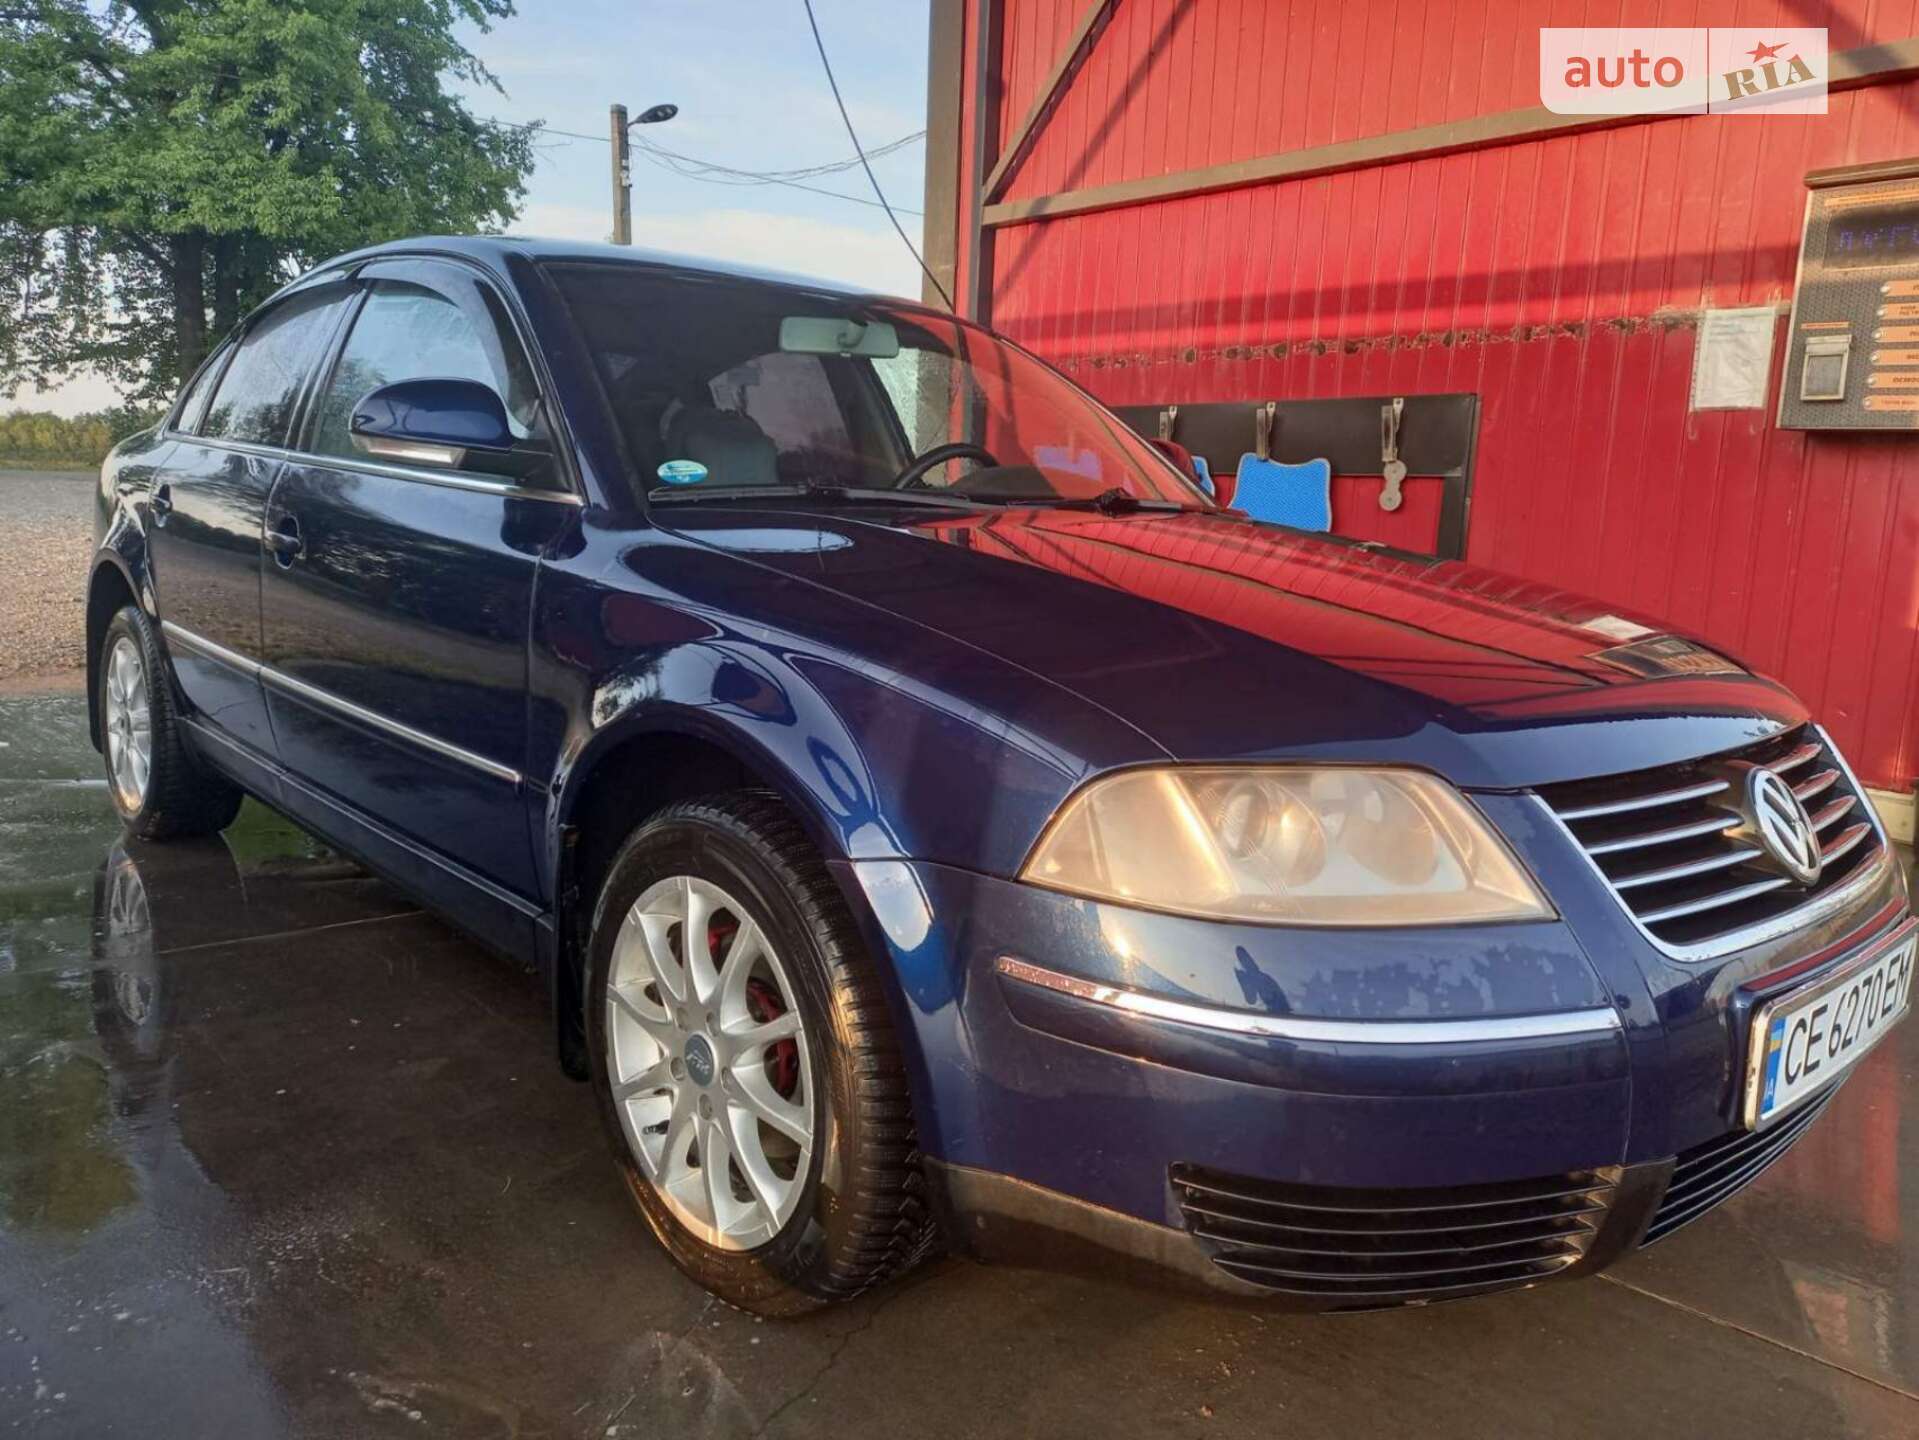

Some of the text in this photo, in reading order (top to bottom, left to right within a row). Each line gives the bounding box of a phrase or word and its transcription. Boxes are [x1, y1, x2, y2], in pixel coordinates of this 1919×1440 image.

[1784, 950, 1912, 1085] CE 6270 EM
